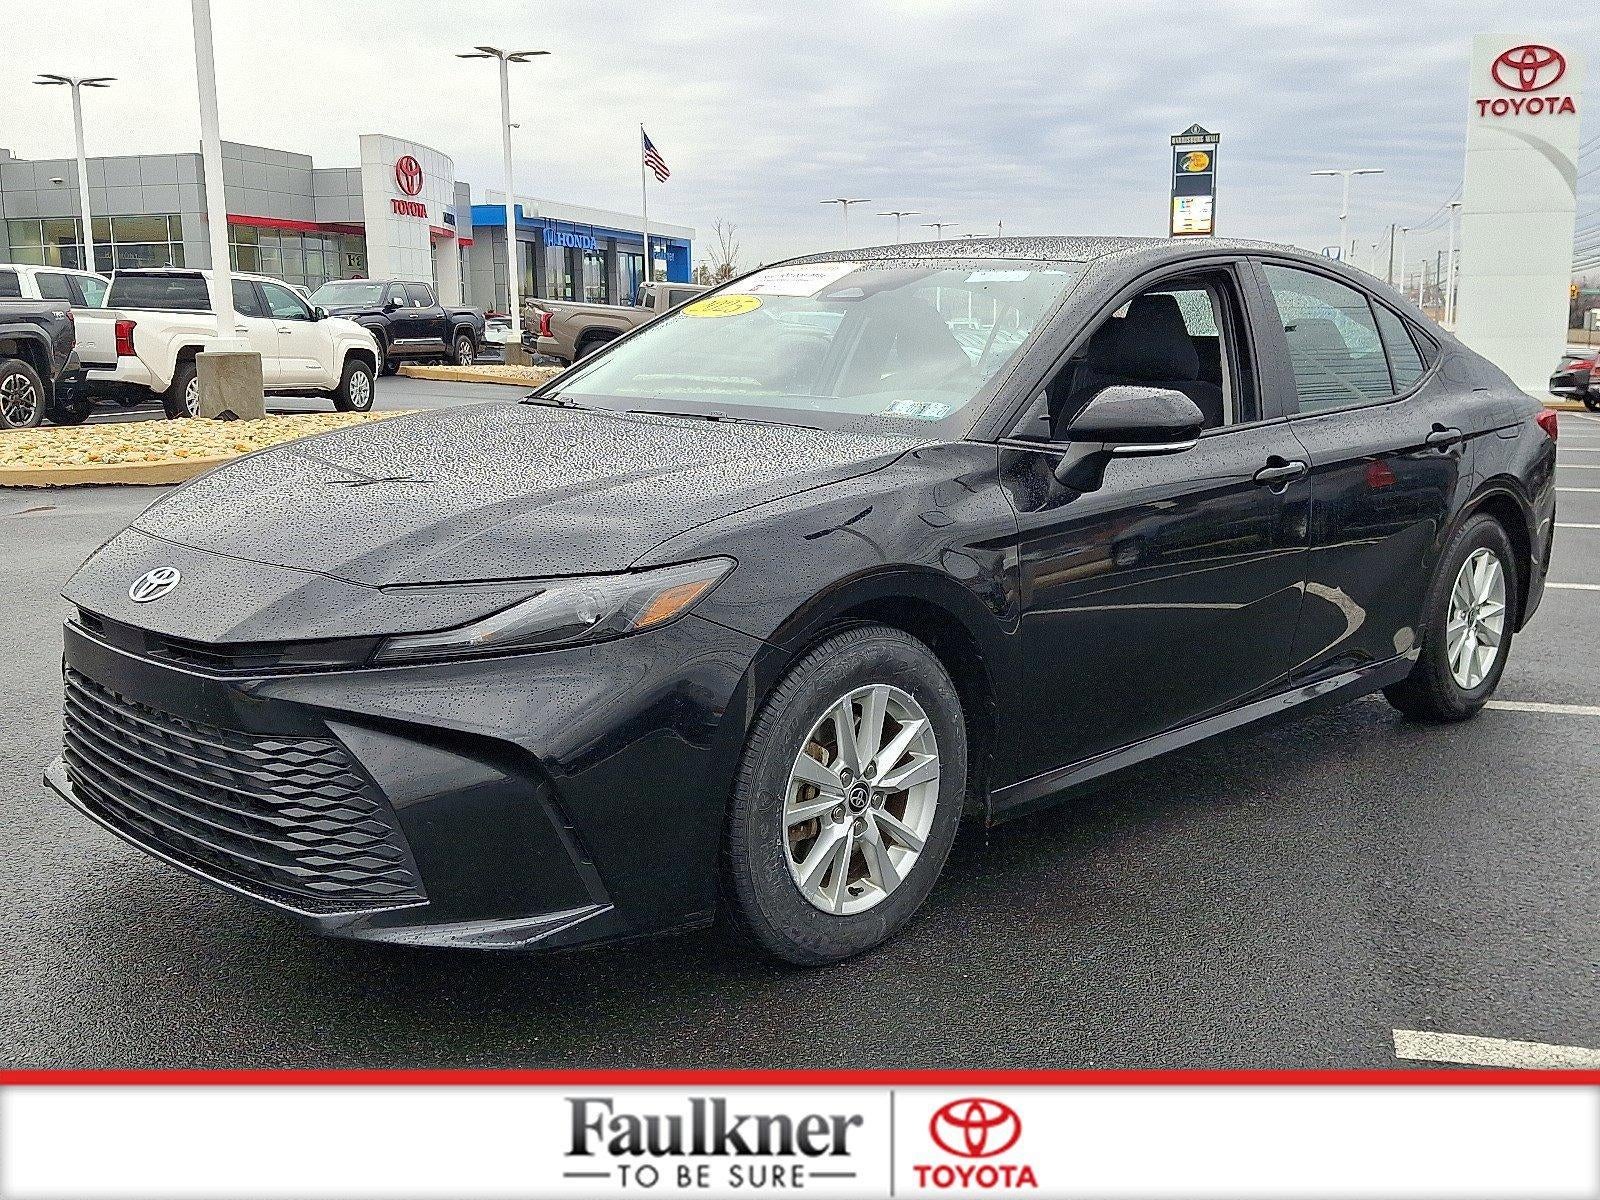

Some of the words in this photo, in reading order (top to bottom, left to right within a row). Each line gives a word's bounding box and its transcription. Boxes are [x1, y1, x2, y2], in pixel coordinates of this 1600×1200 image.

[1476, 97, 1576, 117] TOYOTA
[391, 199, 428, 219] TOYOTA
[556, 232, 599, 250] HONDA
